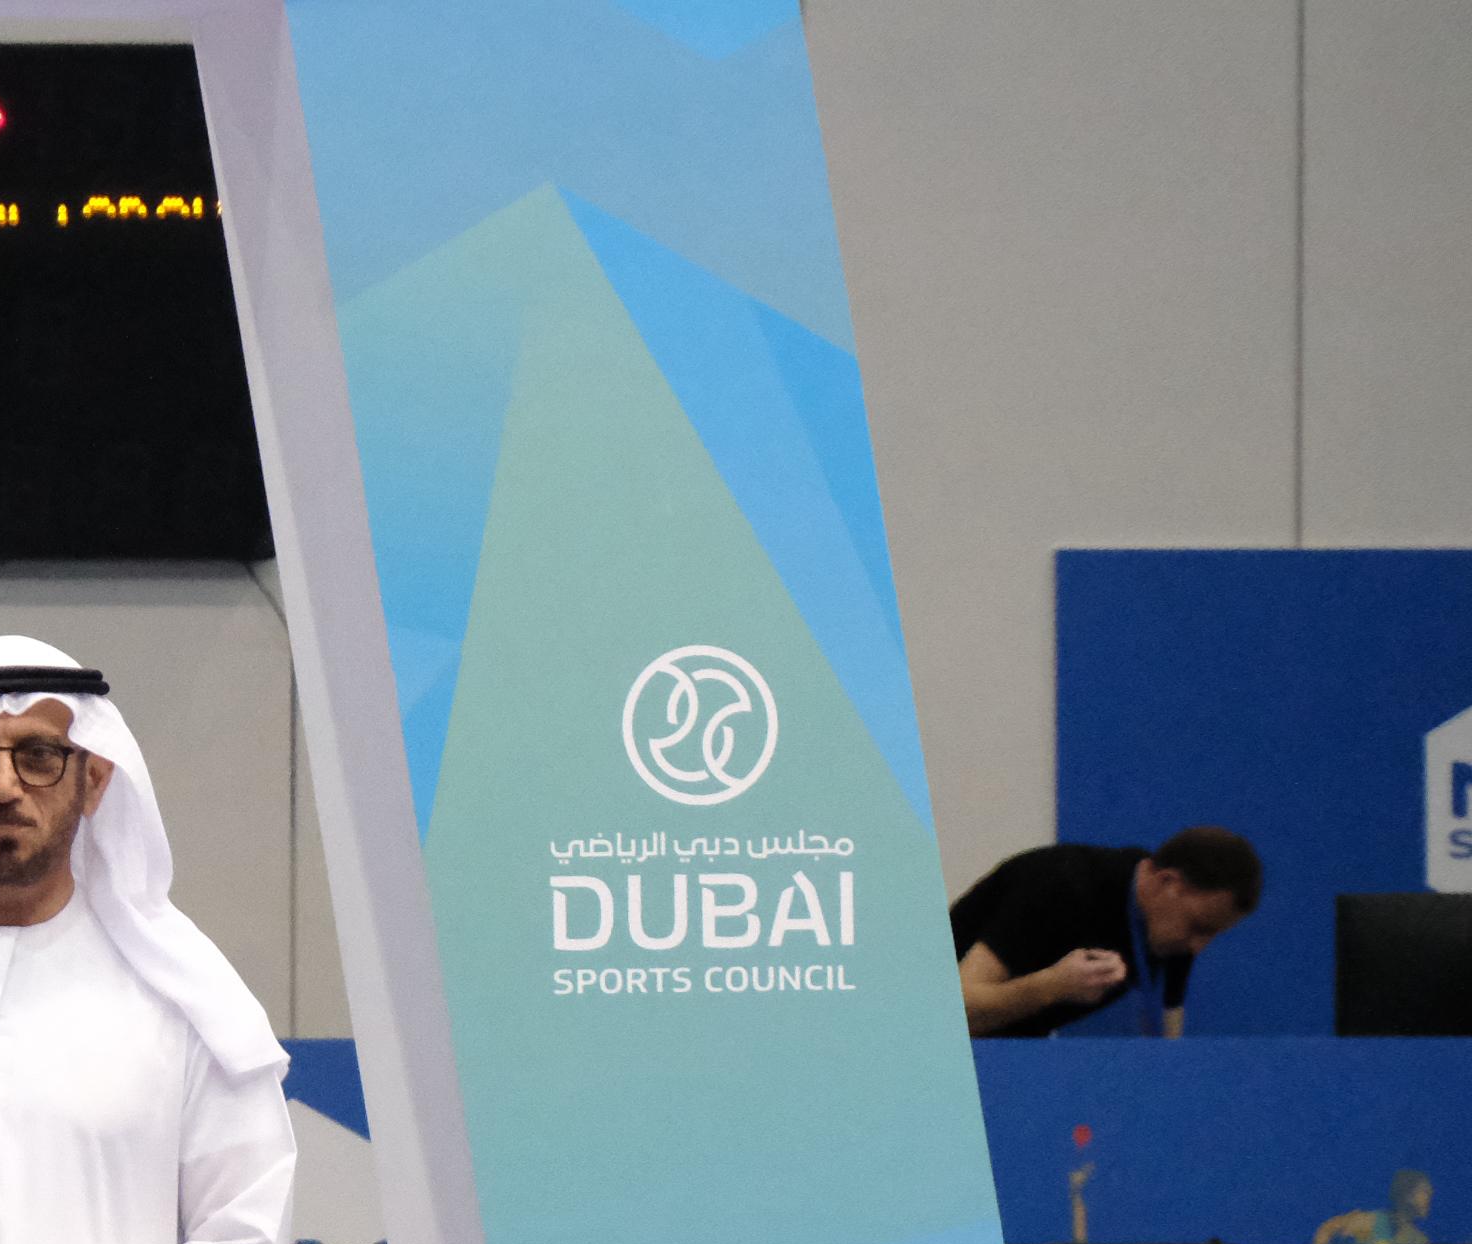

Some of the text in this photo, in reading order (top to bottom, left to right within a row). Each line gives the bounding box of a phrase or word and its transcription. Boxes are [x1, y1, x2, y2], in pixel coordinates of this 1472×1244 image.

[550, 829, 855, 865] مجلس دبي الرياضي
[550, 870, 855, 952] DUBAI
[553, 964, 856, 995] SPORTS COUNCIL
